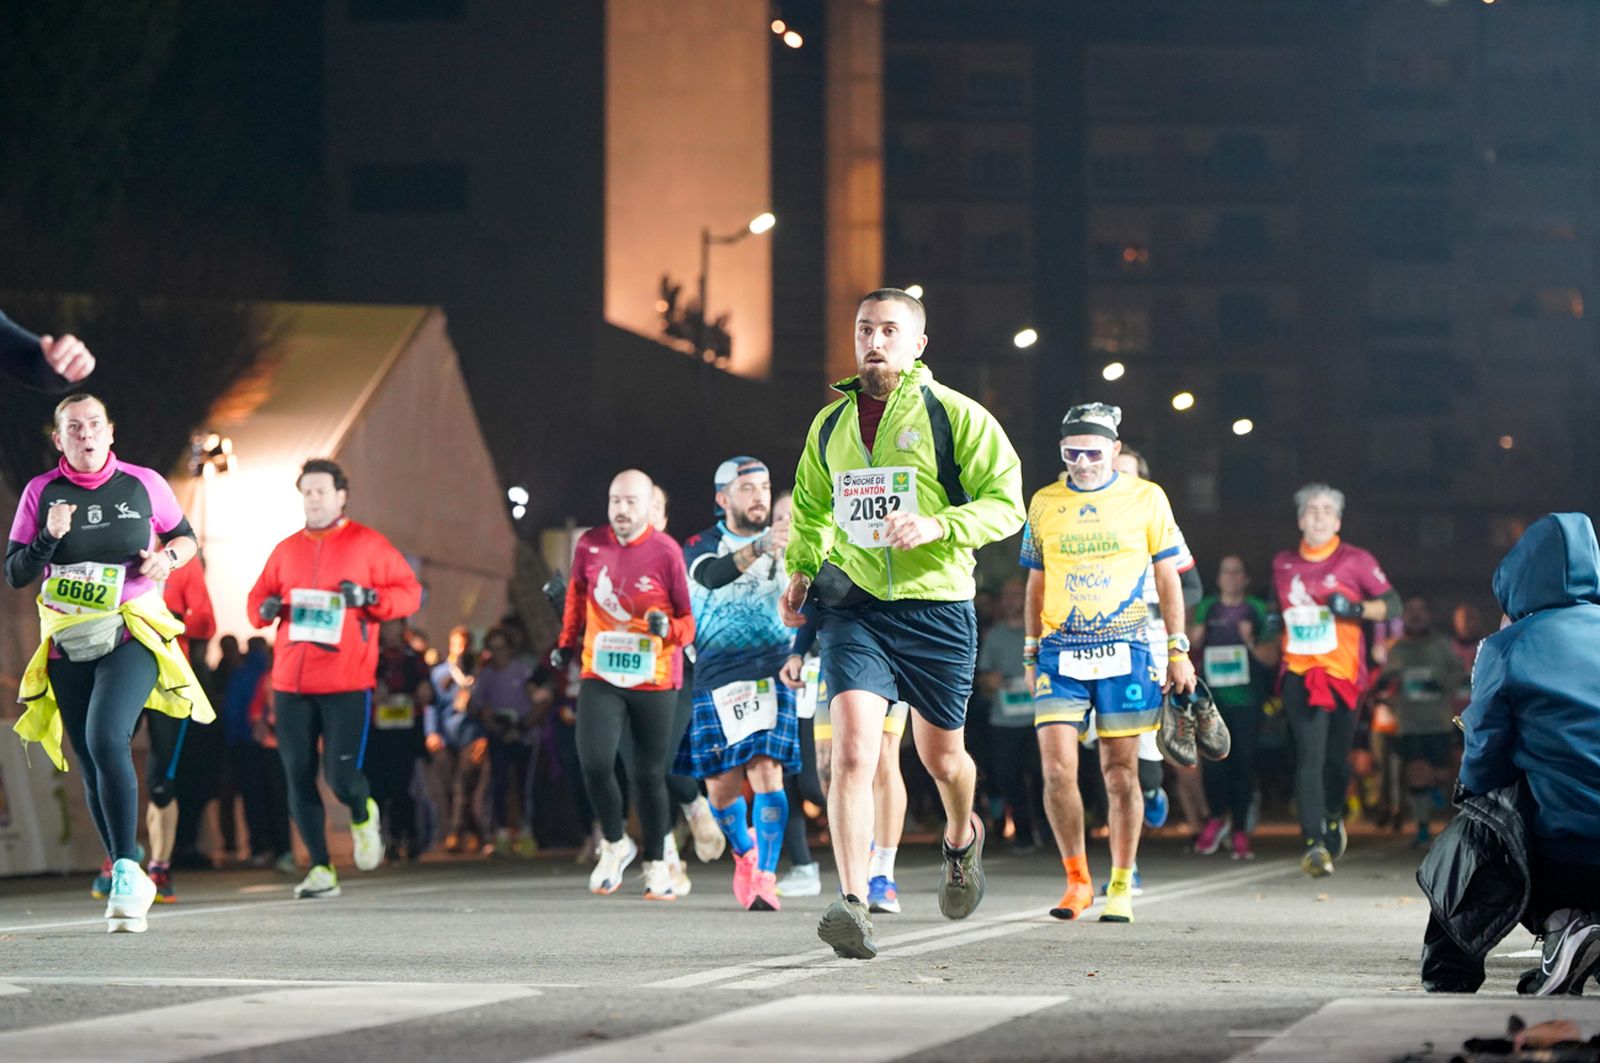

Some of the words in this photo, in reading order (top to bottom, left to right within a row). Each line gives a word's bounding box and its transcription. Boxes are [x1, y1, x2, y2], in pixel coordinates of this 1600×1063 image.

[852, 477, 874, 486] NOCHE
[876, 476, 885, 485] DE
[844, 488, 859, 497] SAN
[860, 485, 886, 496] ANTÓN
[850, 495, 901, 521] 2032
[1060, 532, 1103, 543] CANILLAS
[1106, 531, 1117, 540] DE
[1060, 541, 1119, 554] ALBAIDA
[56, 579, 107, 604] 6682
[608, 652, 641, 669] 1169
